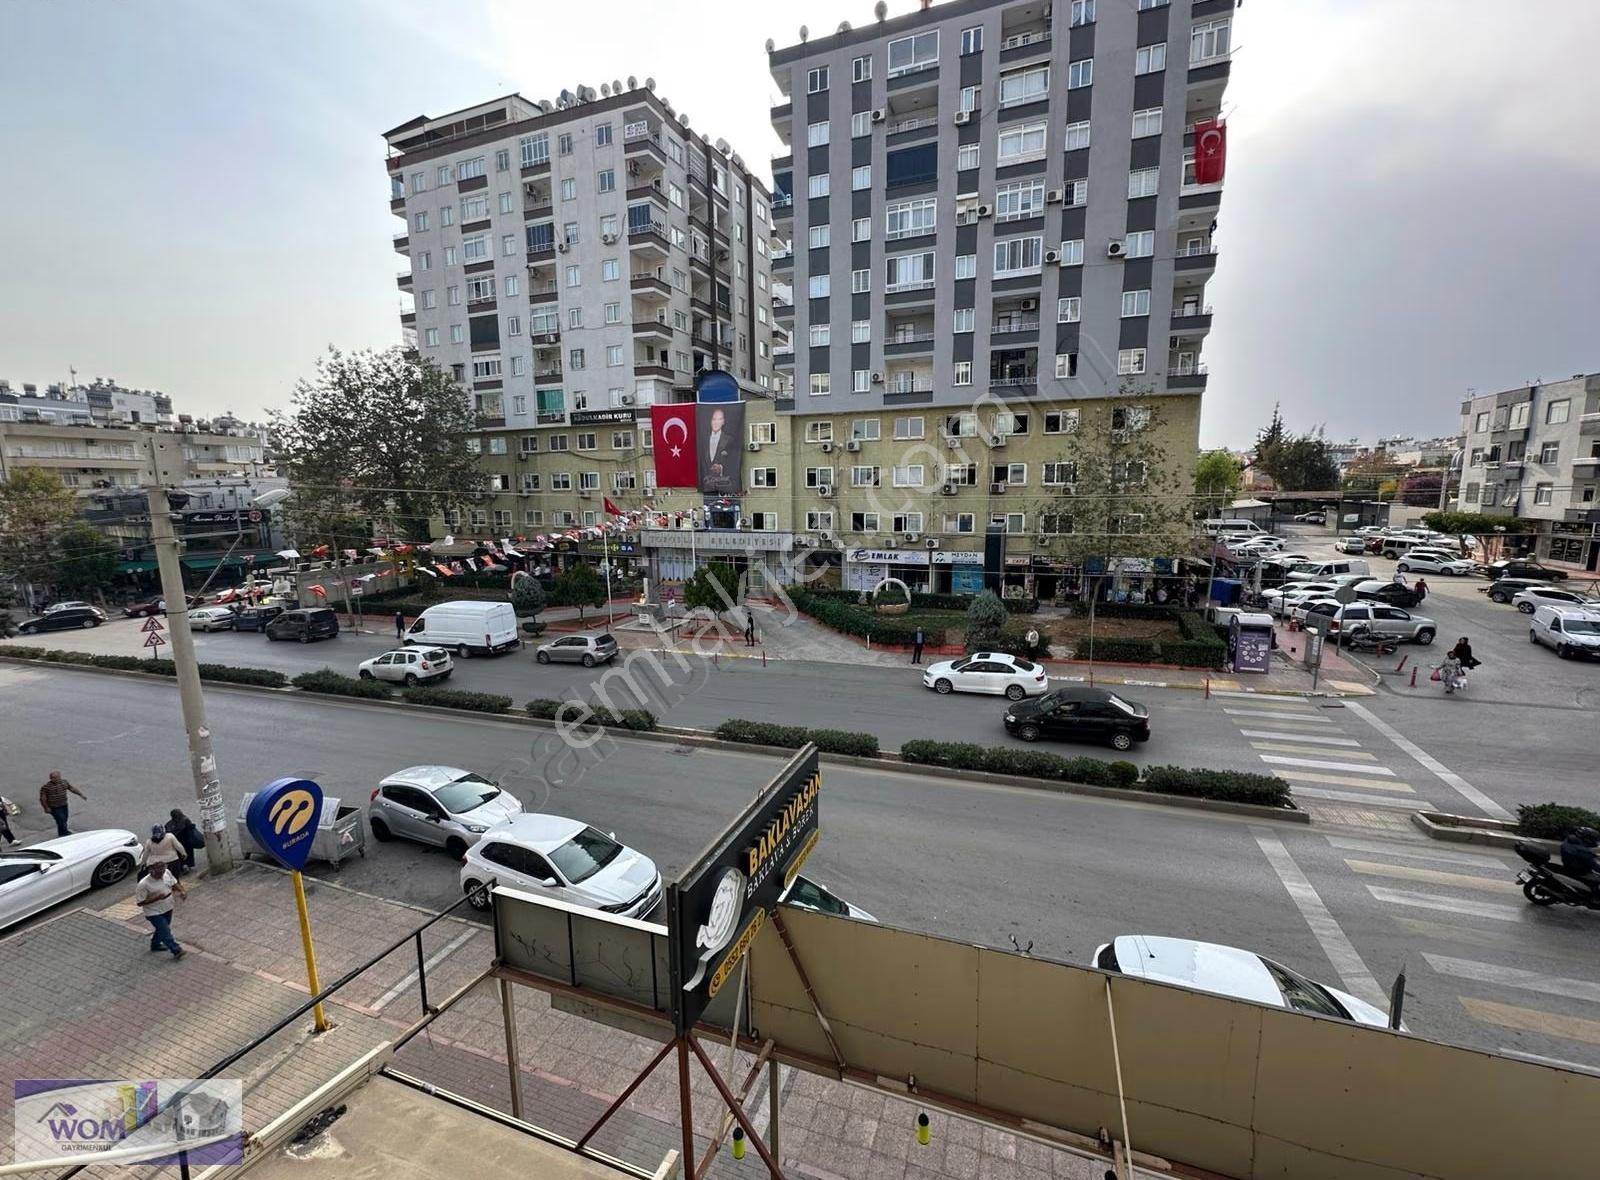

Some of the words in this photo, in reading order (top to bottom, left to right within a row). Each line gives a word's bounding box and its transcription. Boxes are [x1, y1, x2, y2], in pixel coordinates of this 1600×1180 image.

[871, 552, 899, 560] EMLAK
[748, 770, 822, 878] BAKLAVASAN
[747, 842, 785, 900] BAKLAVA
